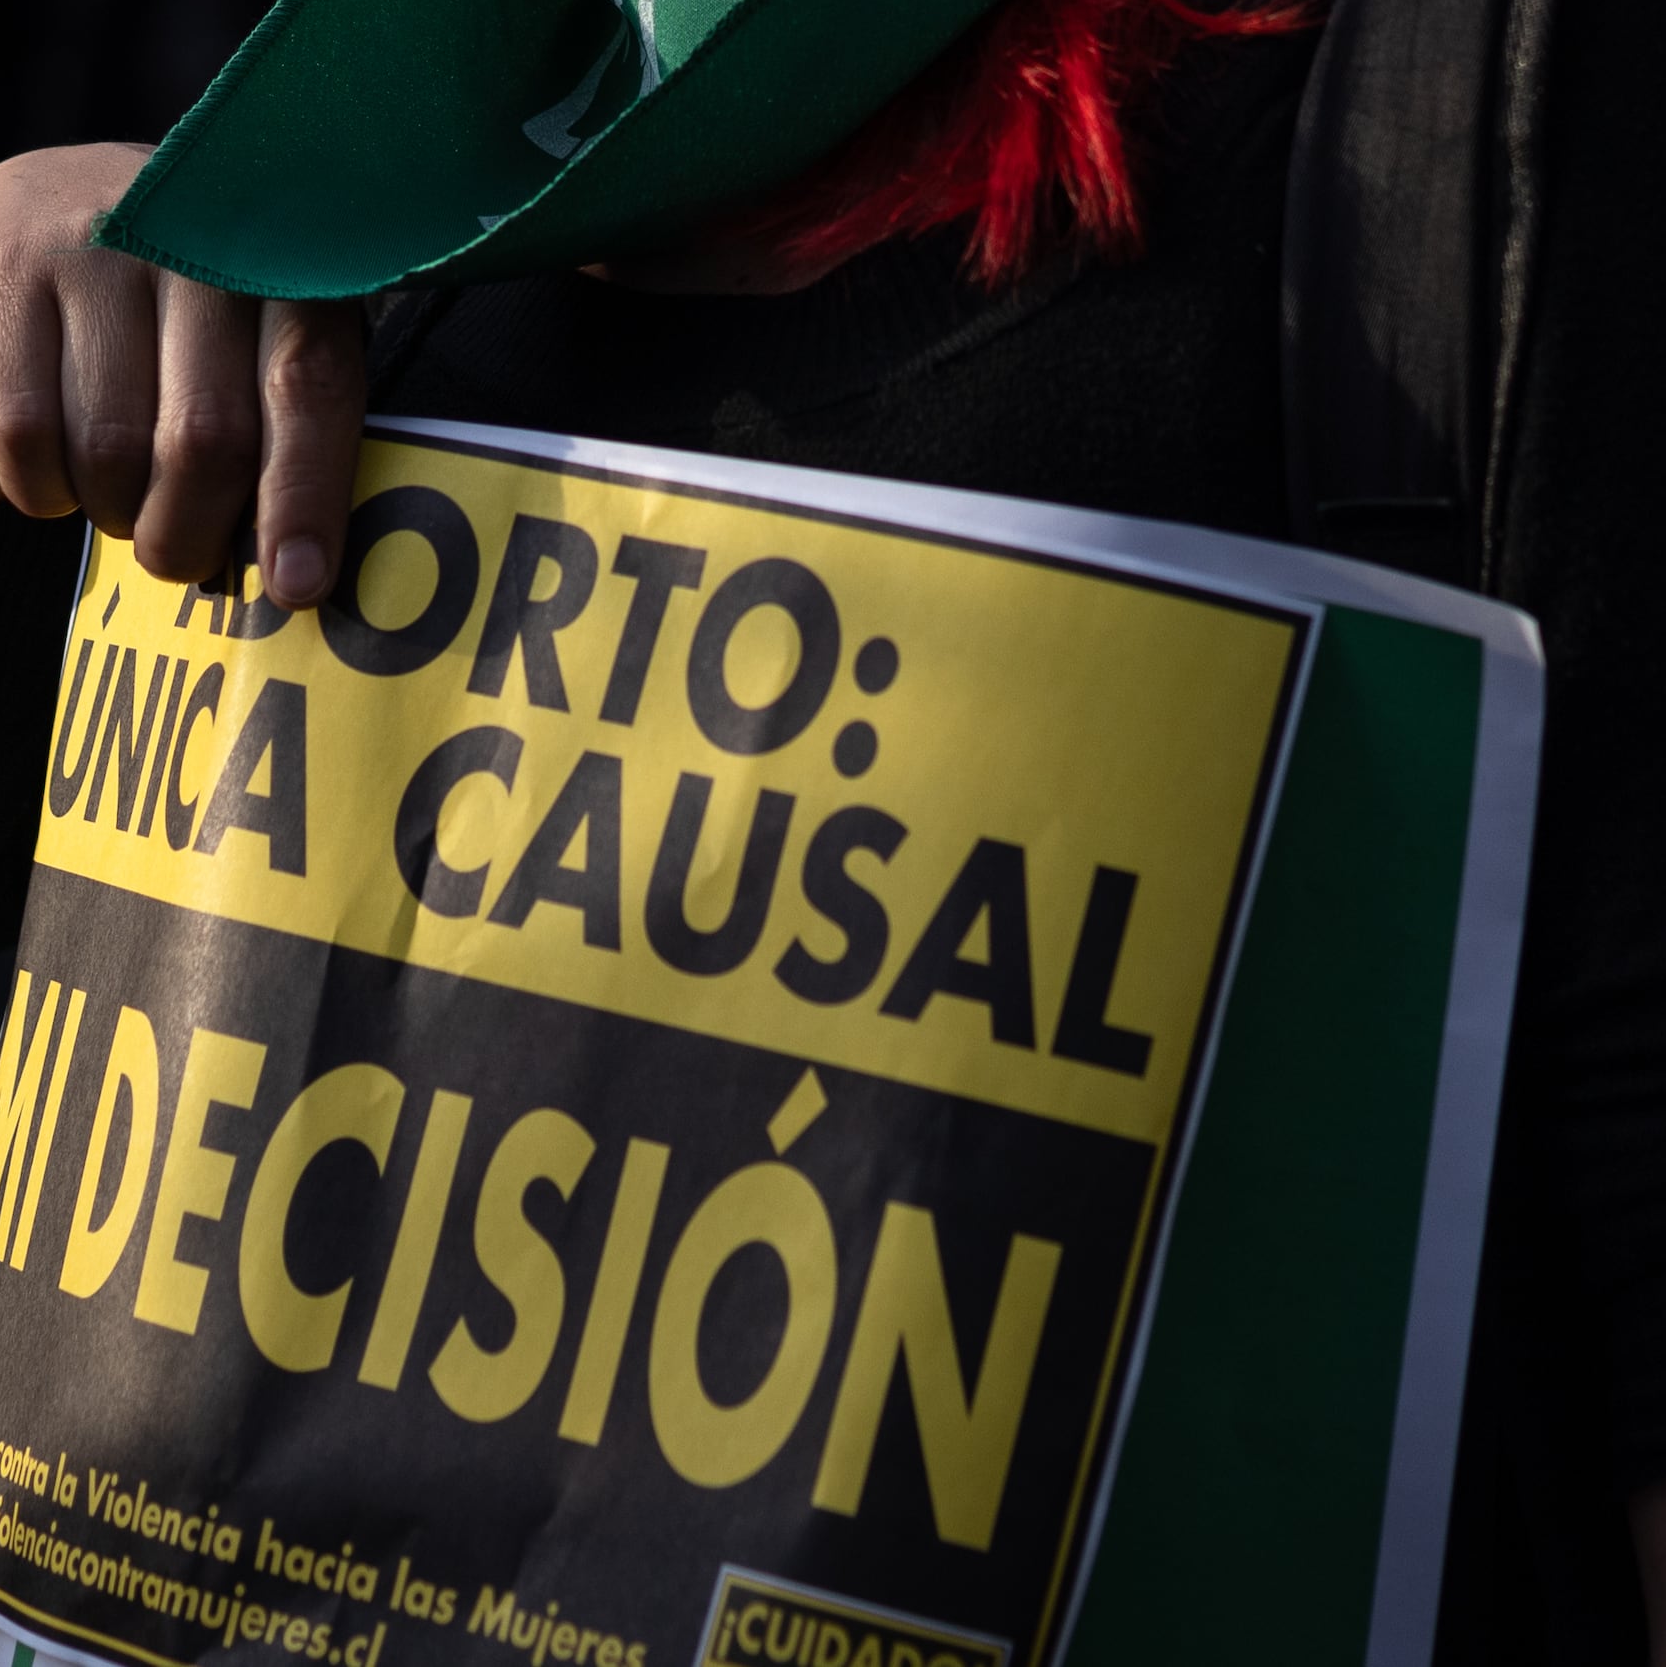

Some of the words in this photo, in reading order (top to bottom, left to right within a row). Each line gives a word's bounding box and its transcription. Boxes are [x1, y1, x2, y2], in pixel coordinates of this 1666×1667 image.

[49, 581, 306, 878] ÚNICA
[394, 725, 1154, 1080] CAUSAL
[58, 1005, 1060, 1552] DECISIÓN
[53, 1452, 78, 1508] la
[88, 1468, 242, 1564] Violencia
[254, 1518, 379, 1603] hacia
[390, 1557, 458, 1625] las
[467, 1584, 648, 1667] Mujeres
